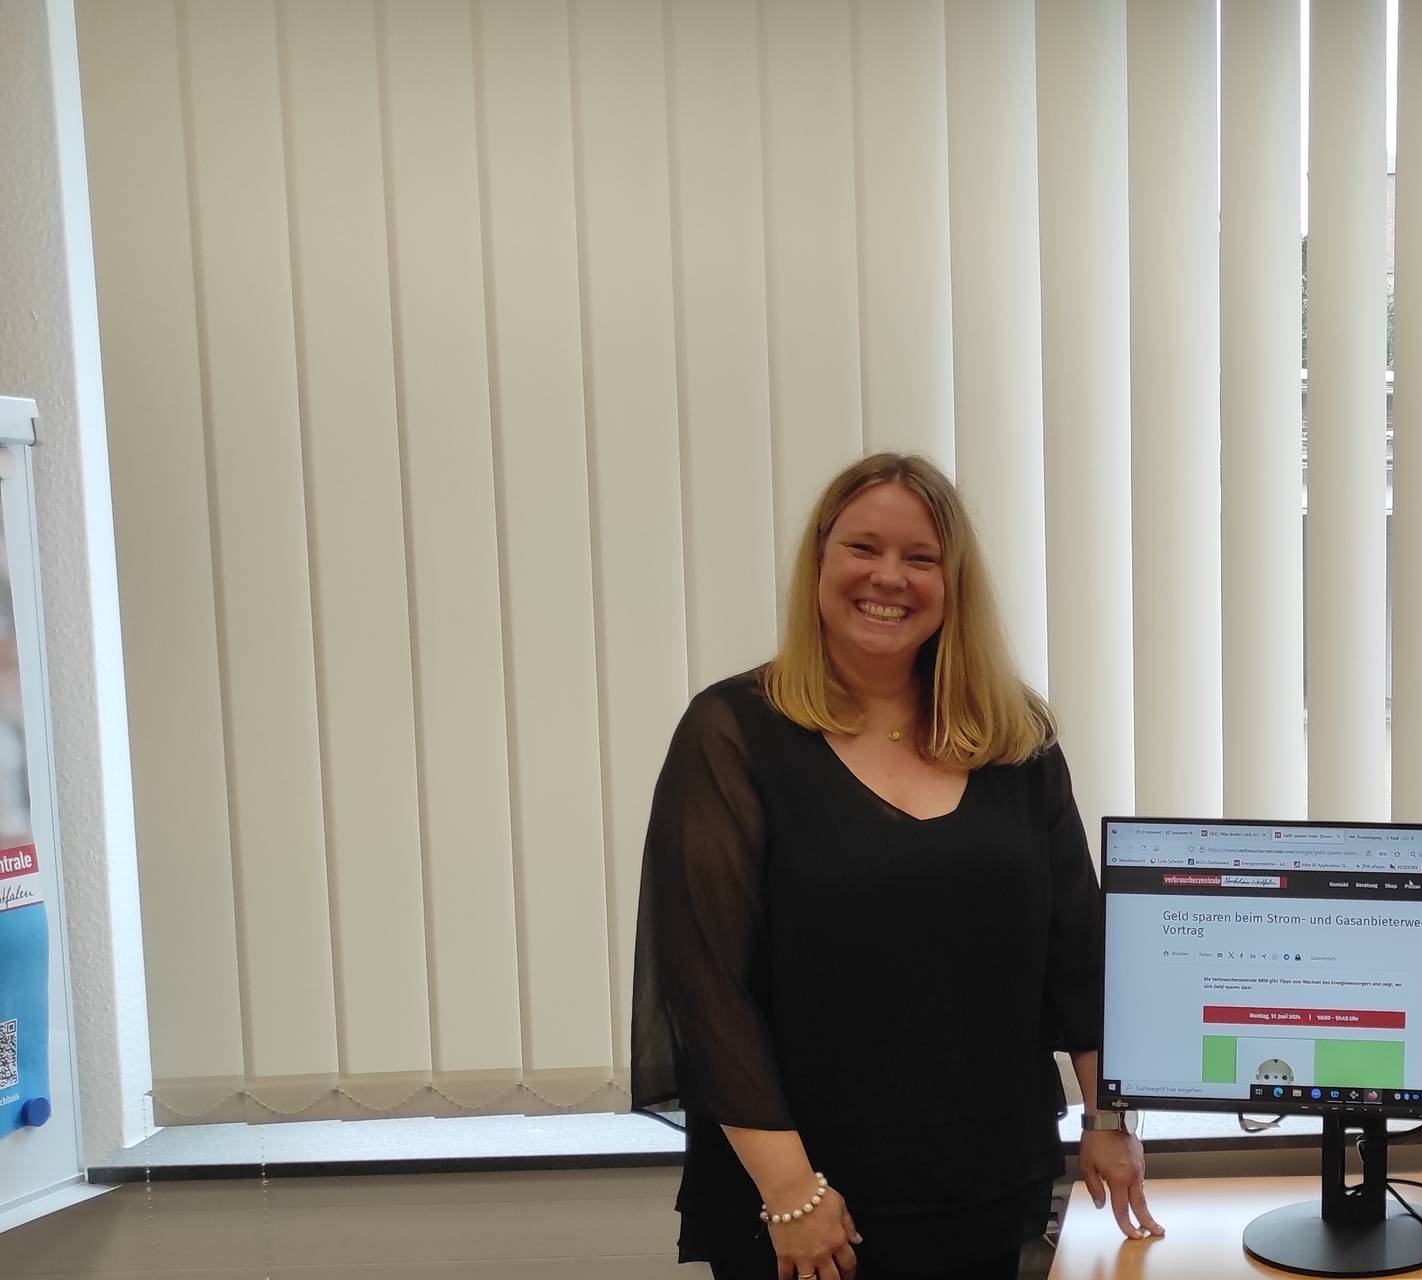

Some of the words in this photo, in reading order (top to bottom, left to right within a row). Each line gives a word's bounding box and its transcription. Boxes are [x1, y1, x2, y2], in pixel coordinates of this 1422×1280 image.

[0, 884, 34, 908] tfalen
[1163, 910, 1188, 921] Geld
[1192, 911, 1231, 924] sparen
[1235, 912, 1263, 923] beim
[1267, 913, 1306, 924] Strom-
[1310, 914, 1331, 925] und
[1162, 924, 1204, 938] Vortrag
